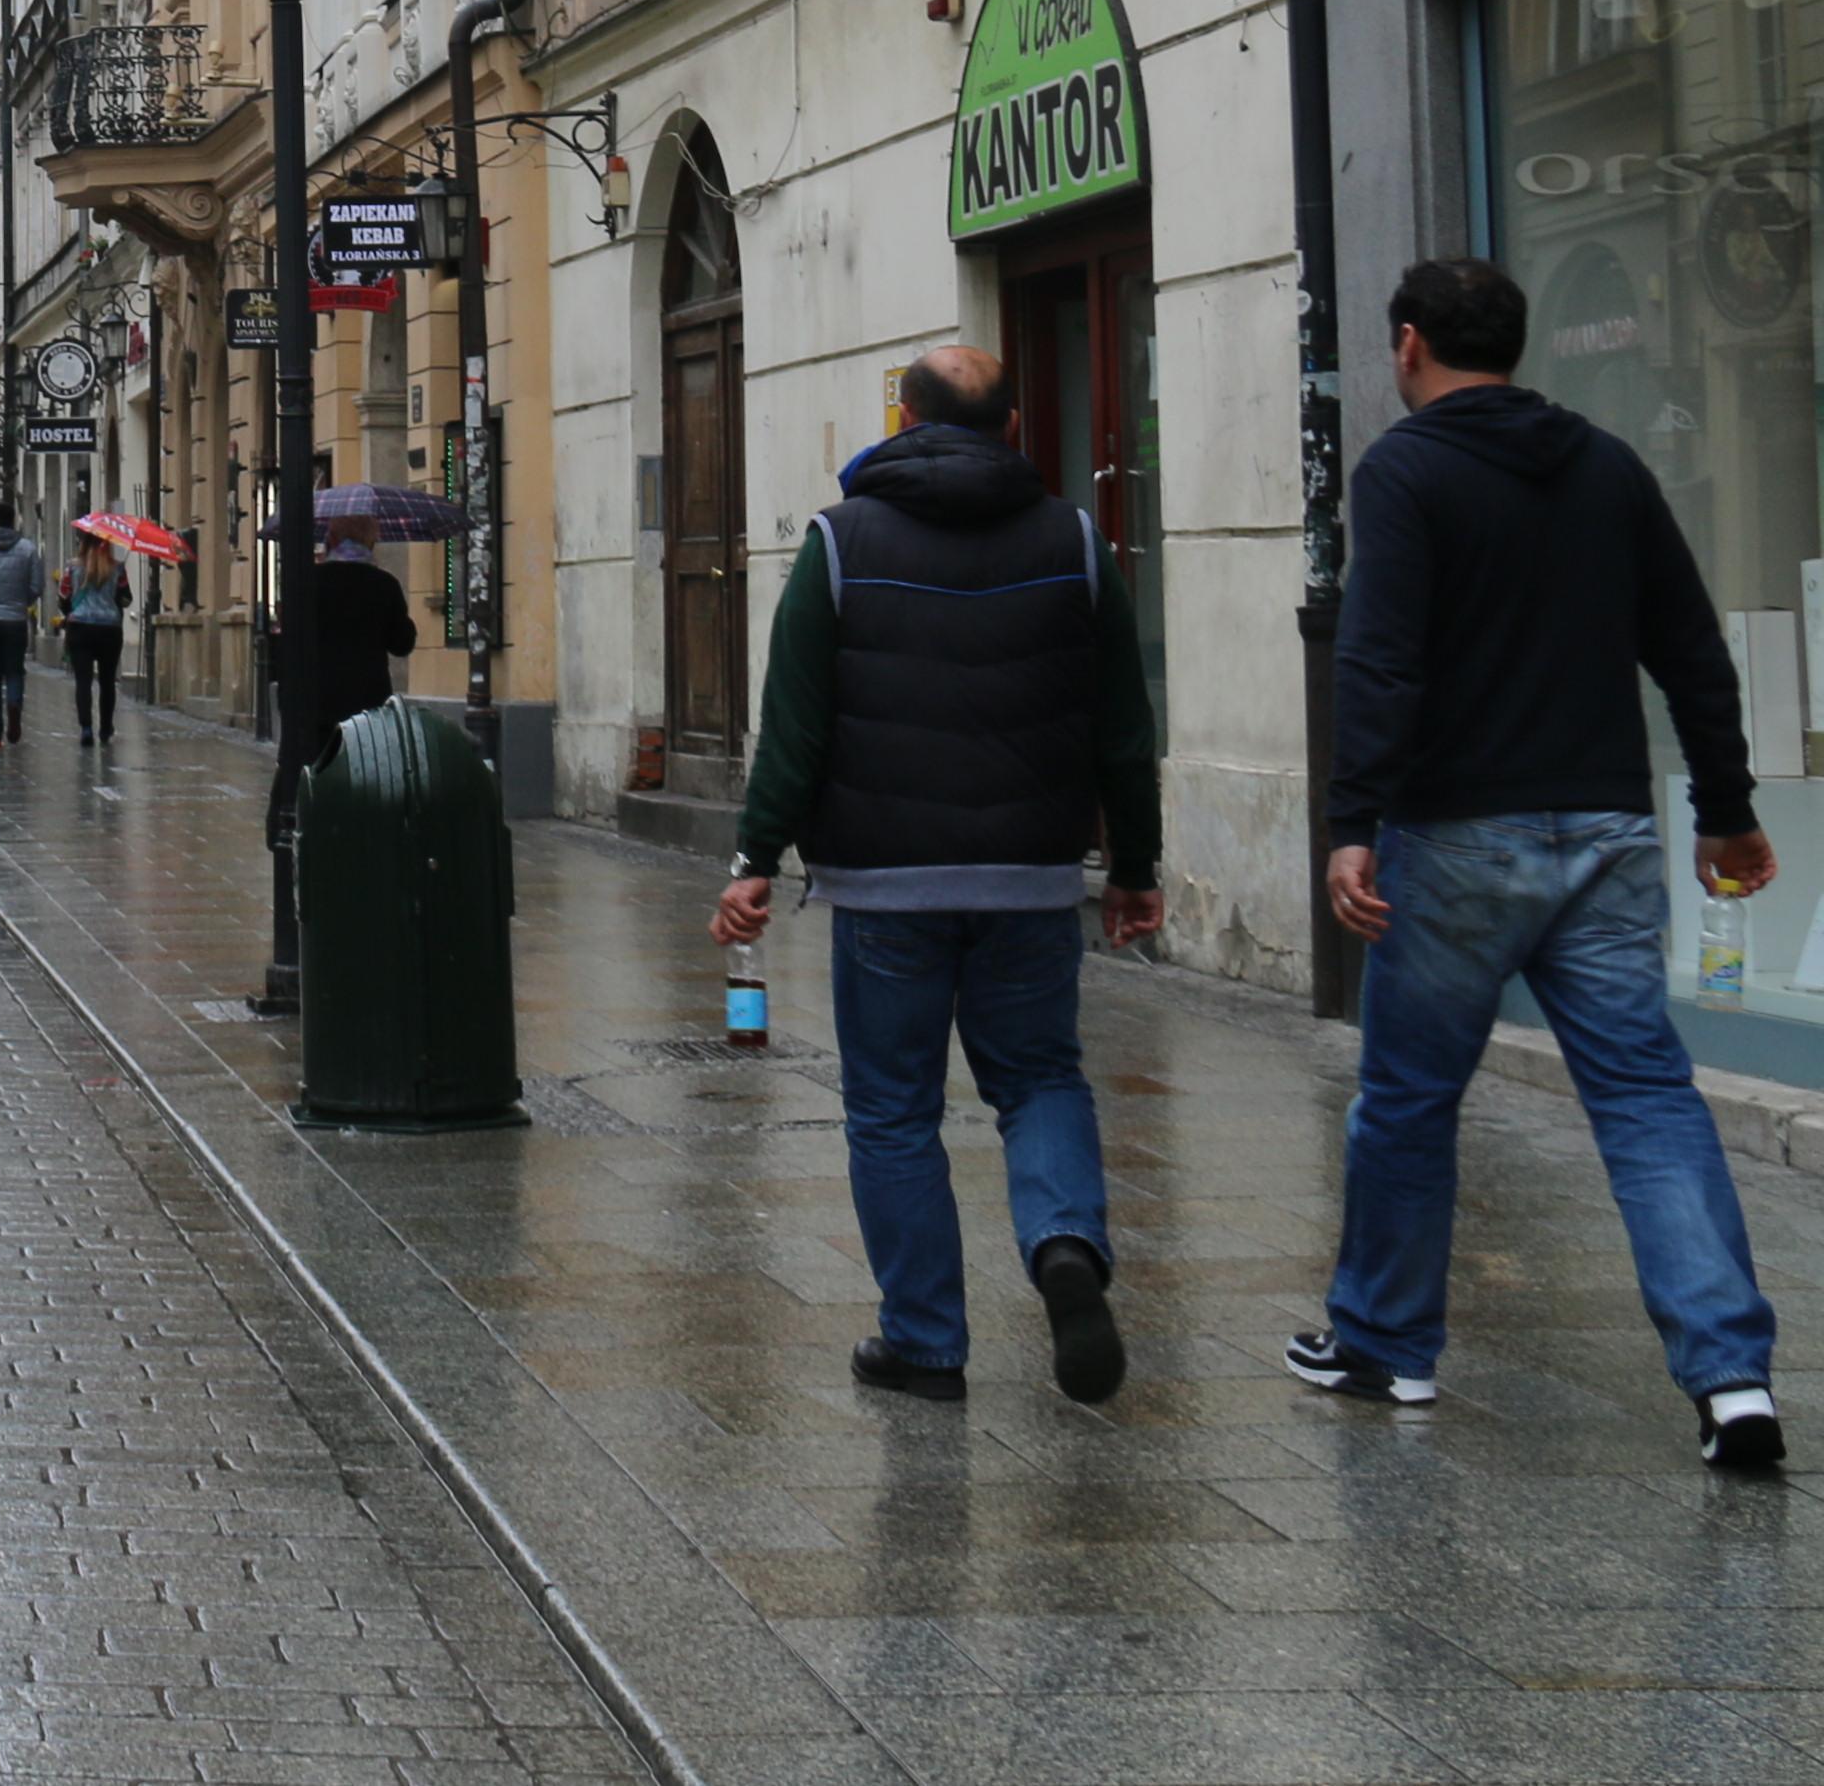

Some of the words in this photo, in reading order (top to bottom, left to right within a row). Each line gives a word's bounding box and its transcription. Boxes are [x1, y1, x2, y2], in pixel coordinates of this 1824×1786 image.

[960, 60, 1128, 218] KANTOR
[352, 227, 405, 245] KEBAB
[331, 248, 410, 261] FLORIAŃSKA
[29, 428, 93, 443] HOSTEL
